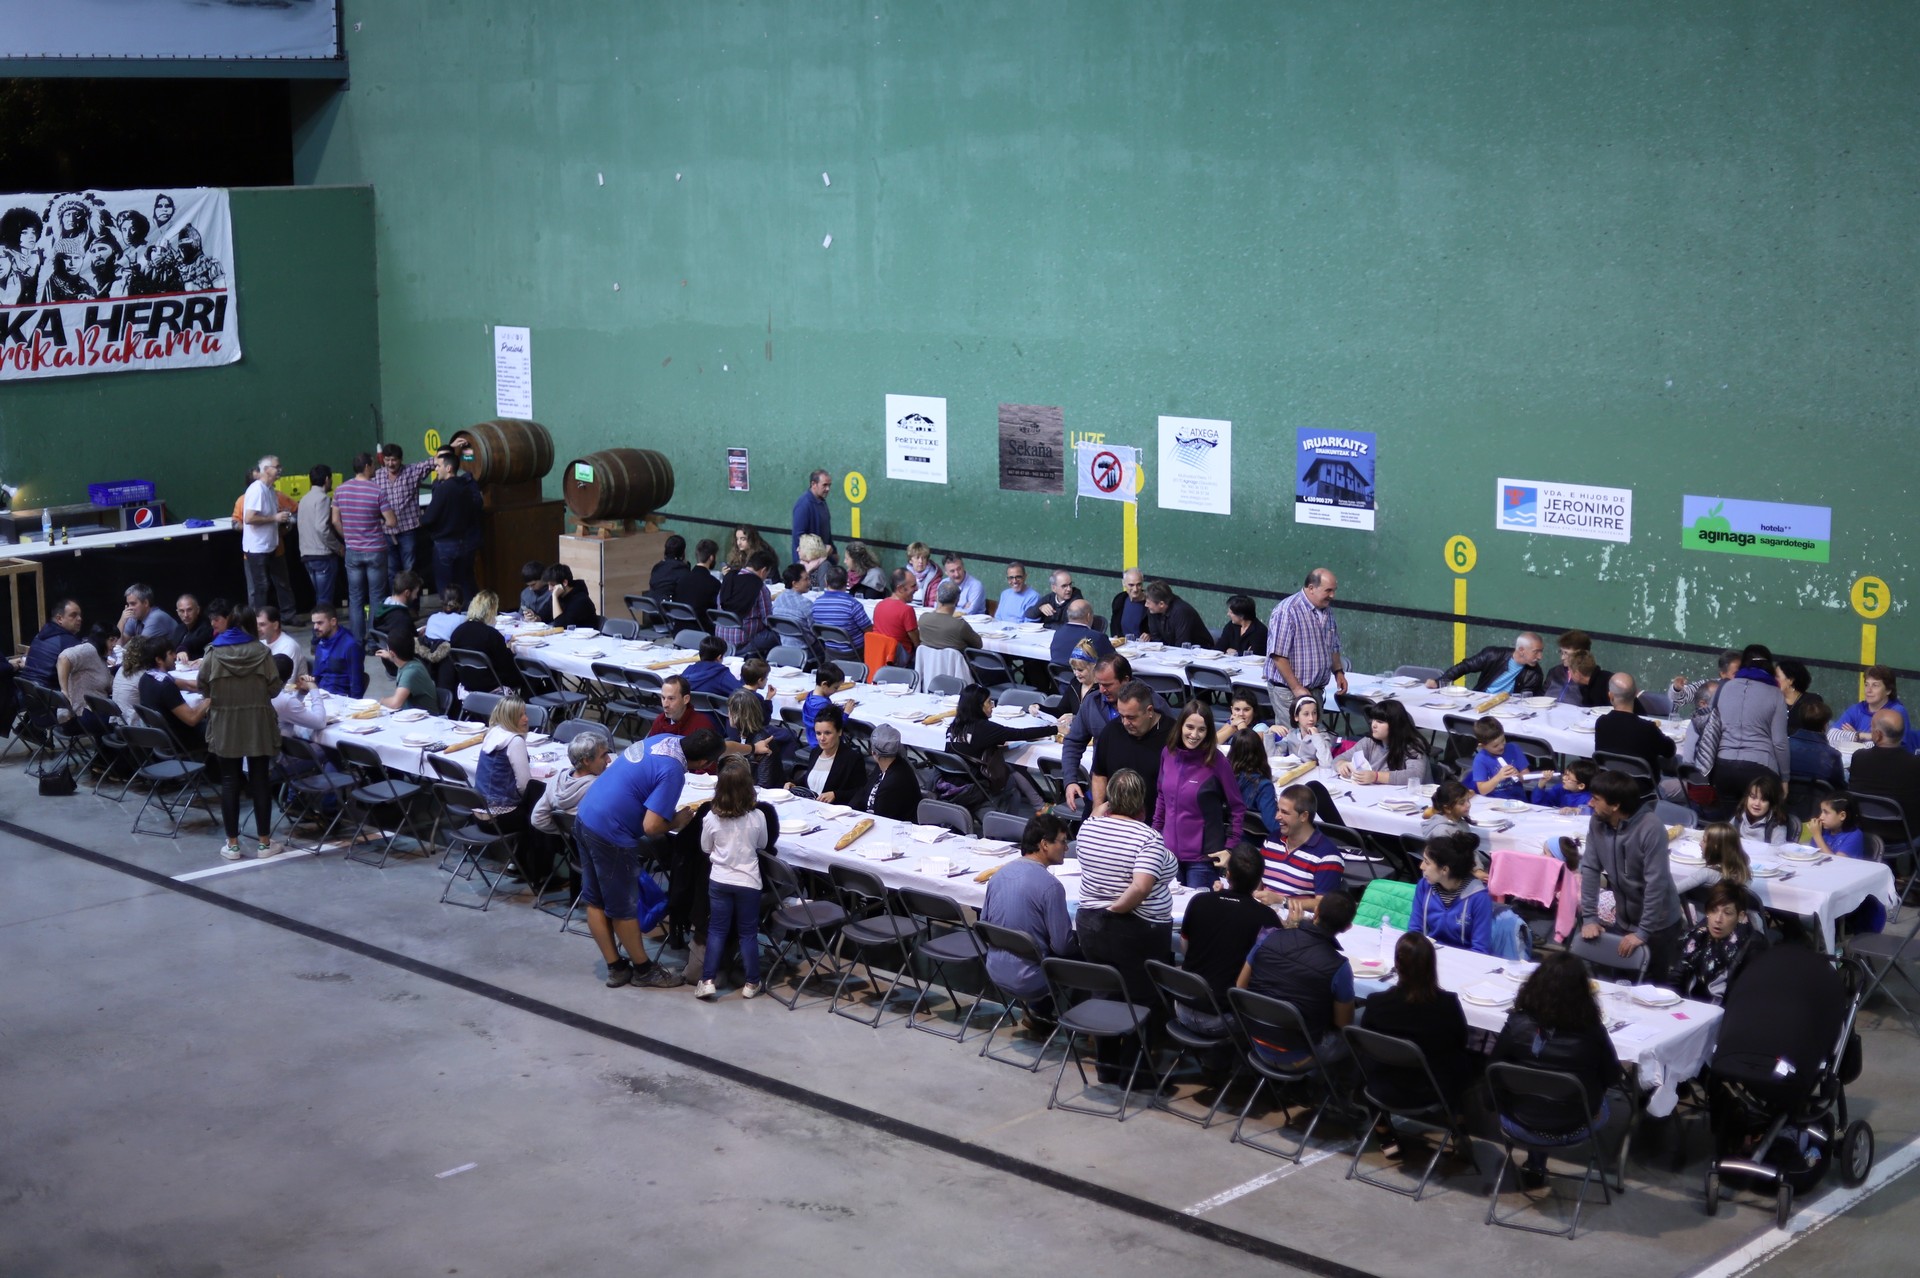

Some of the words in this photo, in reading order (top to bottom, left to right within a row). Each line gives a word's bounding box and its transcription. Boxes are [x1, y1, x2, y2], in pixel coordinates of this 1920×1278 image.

[84, 295, 228, 342] HERRI
[427, 433, 438, 451] 10
[1190, 428, 1219, 438] ATXEGA
[1009, 439, 1053, 457] Sekaña
[1303, 436, 1368, 455] IRUARKAITZ
[1315, 448, 1350, 456] ERAIKUNTZAK
[851, 476, 860, 497] 8
[1544, 499, 1625, 516] JERONIMO
[1544, 511, 1624, 530] IZAGUIRRE
[1699, 529, 1756, 546] aginaga
[1760, 536, 1815, 550] sagardotegia
[1454, 541, 1467, 567] 6
[1862, 582, 1879, 611] 5
